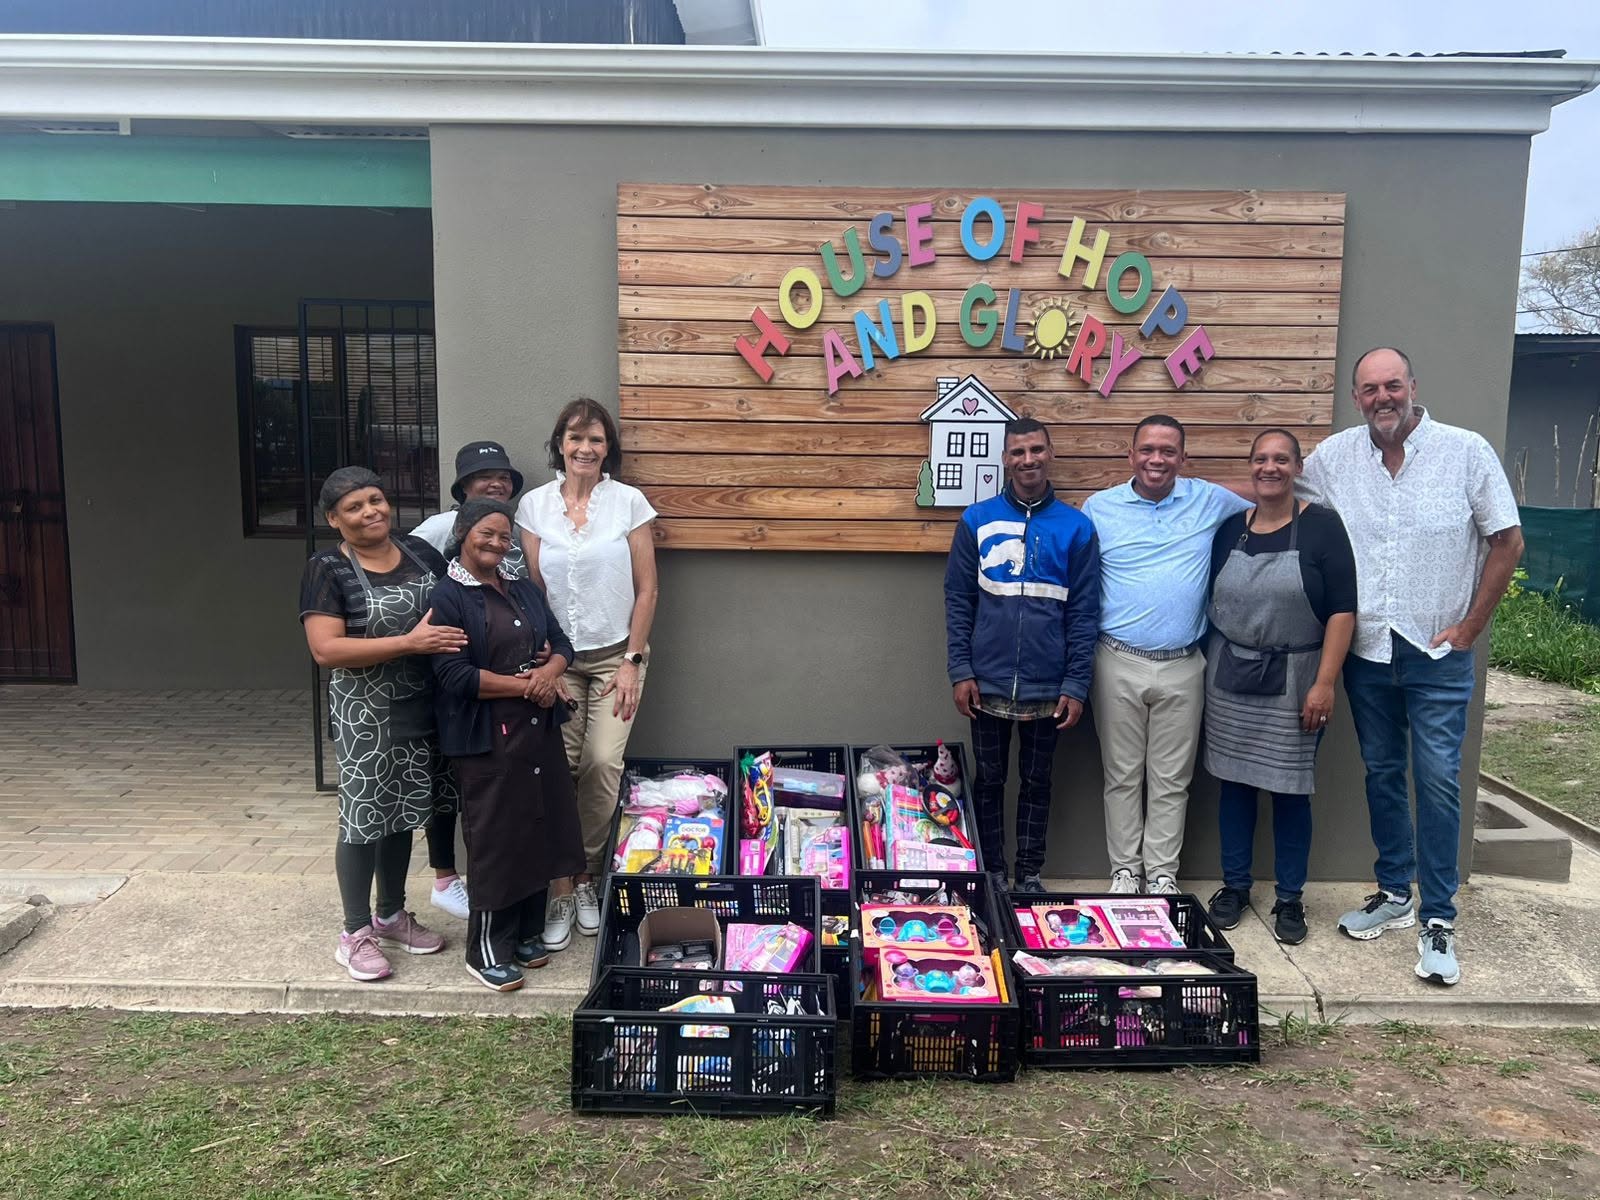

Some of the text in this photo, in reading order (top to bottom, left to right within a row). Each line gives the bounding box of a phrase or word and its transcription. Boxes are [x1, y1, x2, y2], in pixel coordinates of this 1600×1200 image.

[735, 196, 1215, 388] HOUSE OF HOPE
[823, 291, 937, 395] AND
